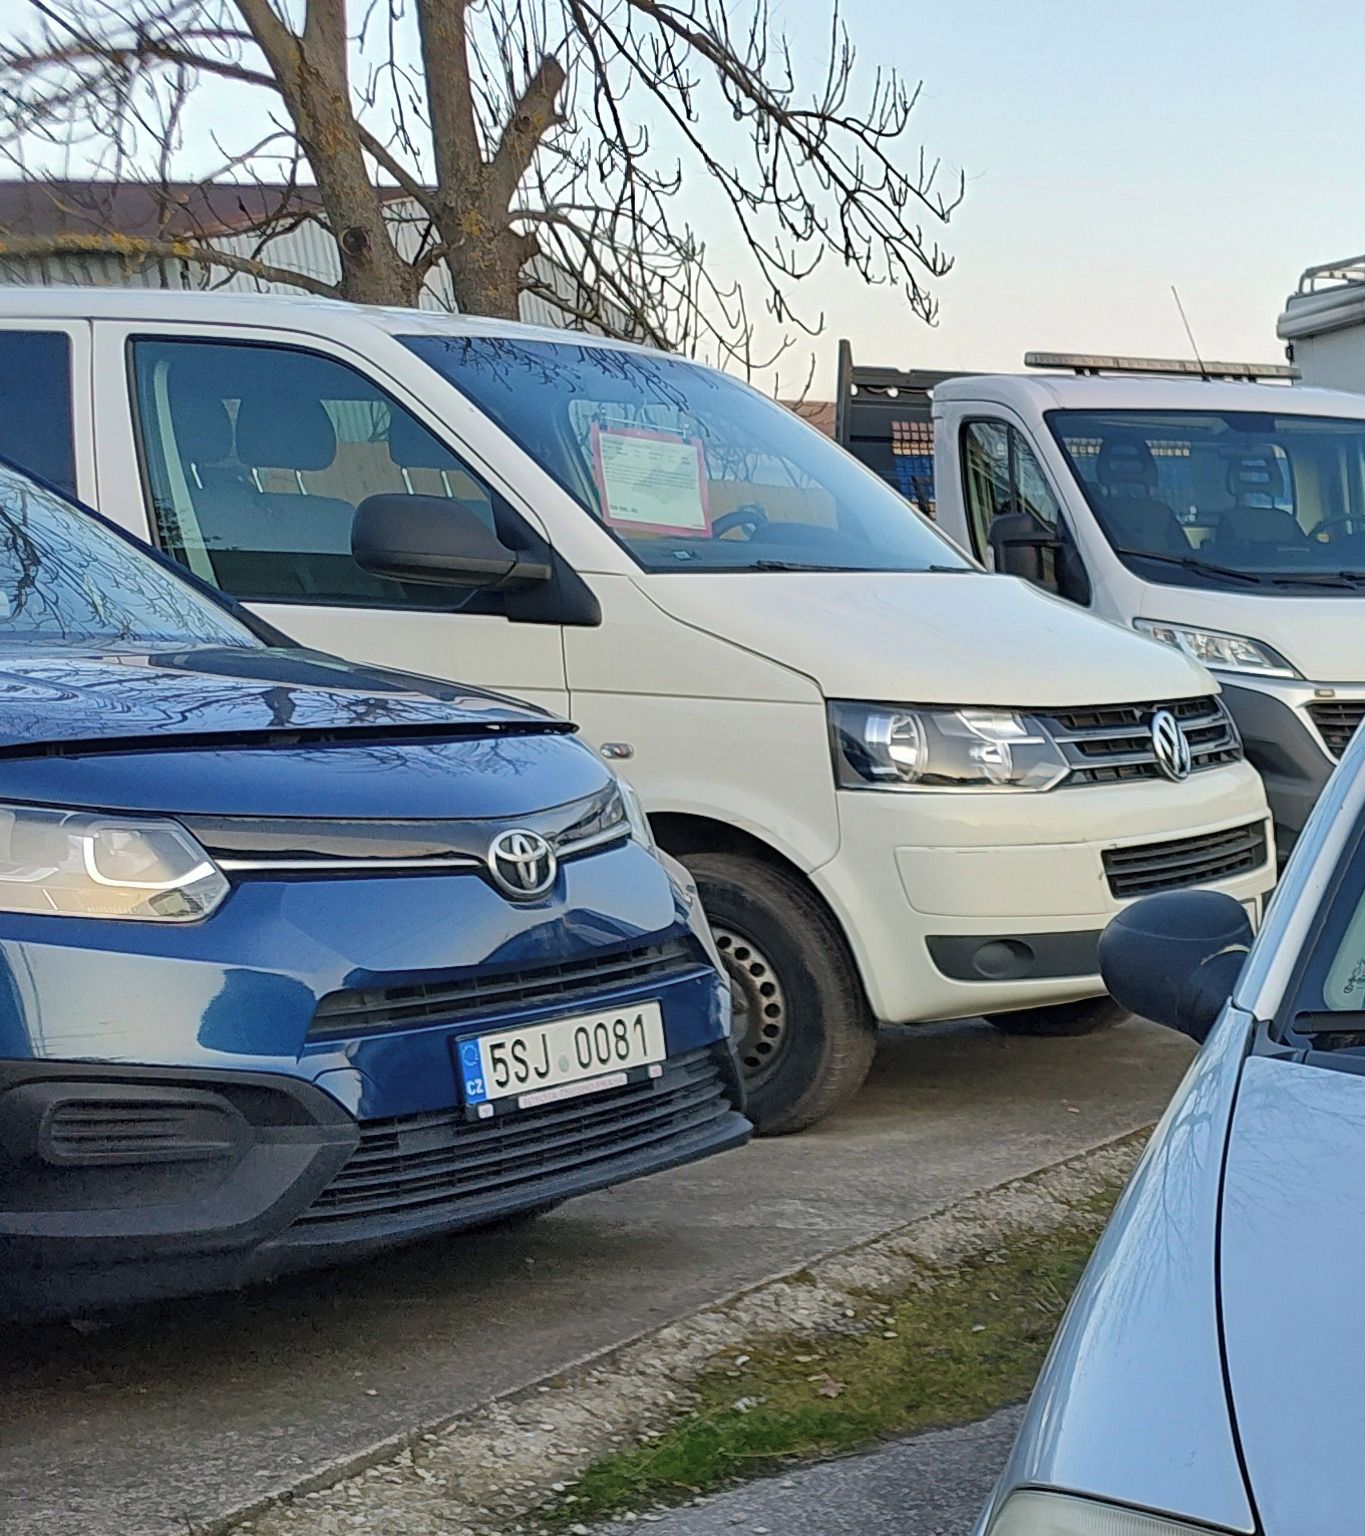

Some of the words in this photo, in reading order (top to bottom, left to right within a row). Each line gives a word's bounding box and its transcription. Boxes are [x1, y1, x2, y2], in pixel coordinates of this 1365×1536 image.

[488, 1033, 550, 1089] 5SJ
[574, 1013, 648, 1070] 0081
[465, 1079, 484, 1096] CZ
